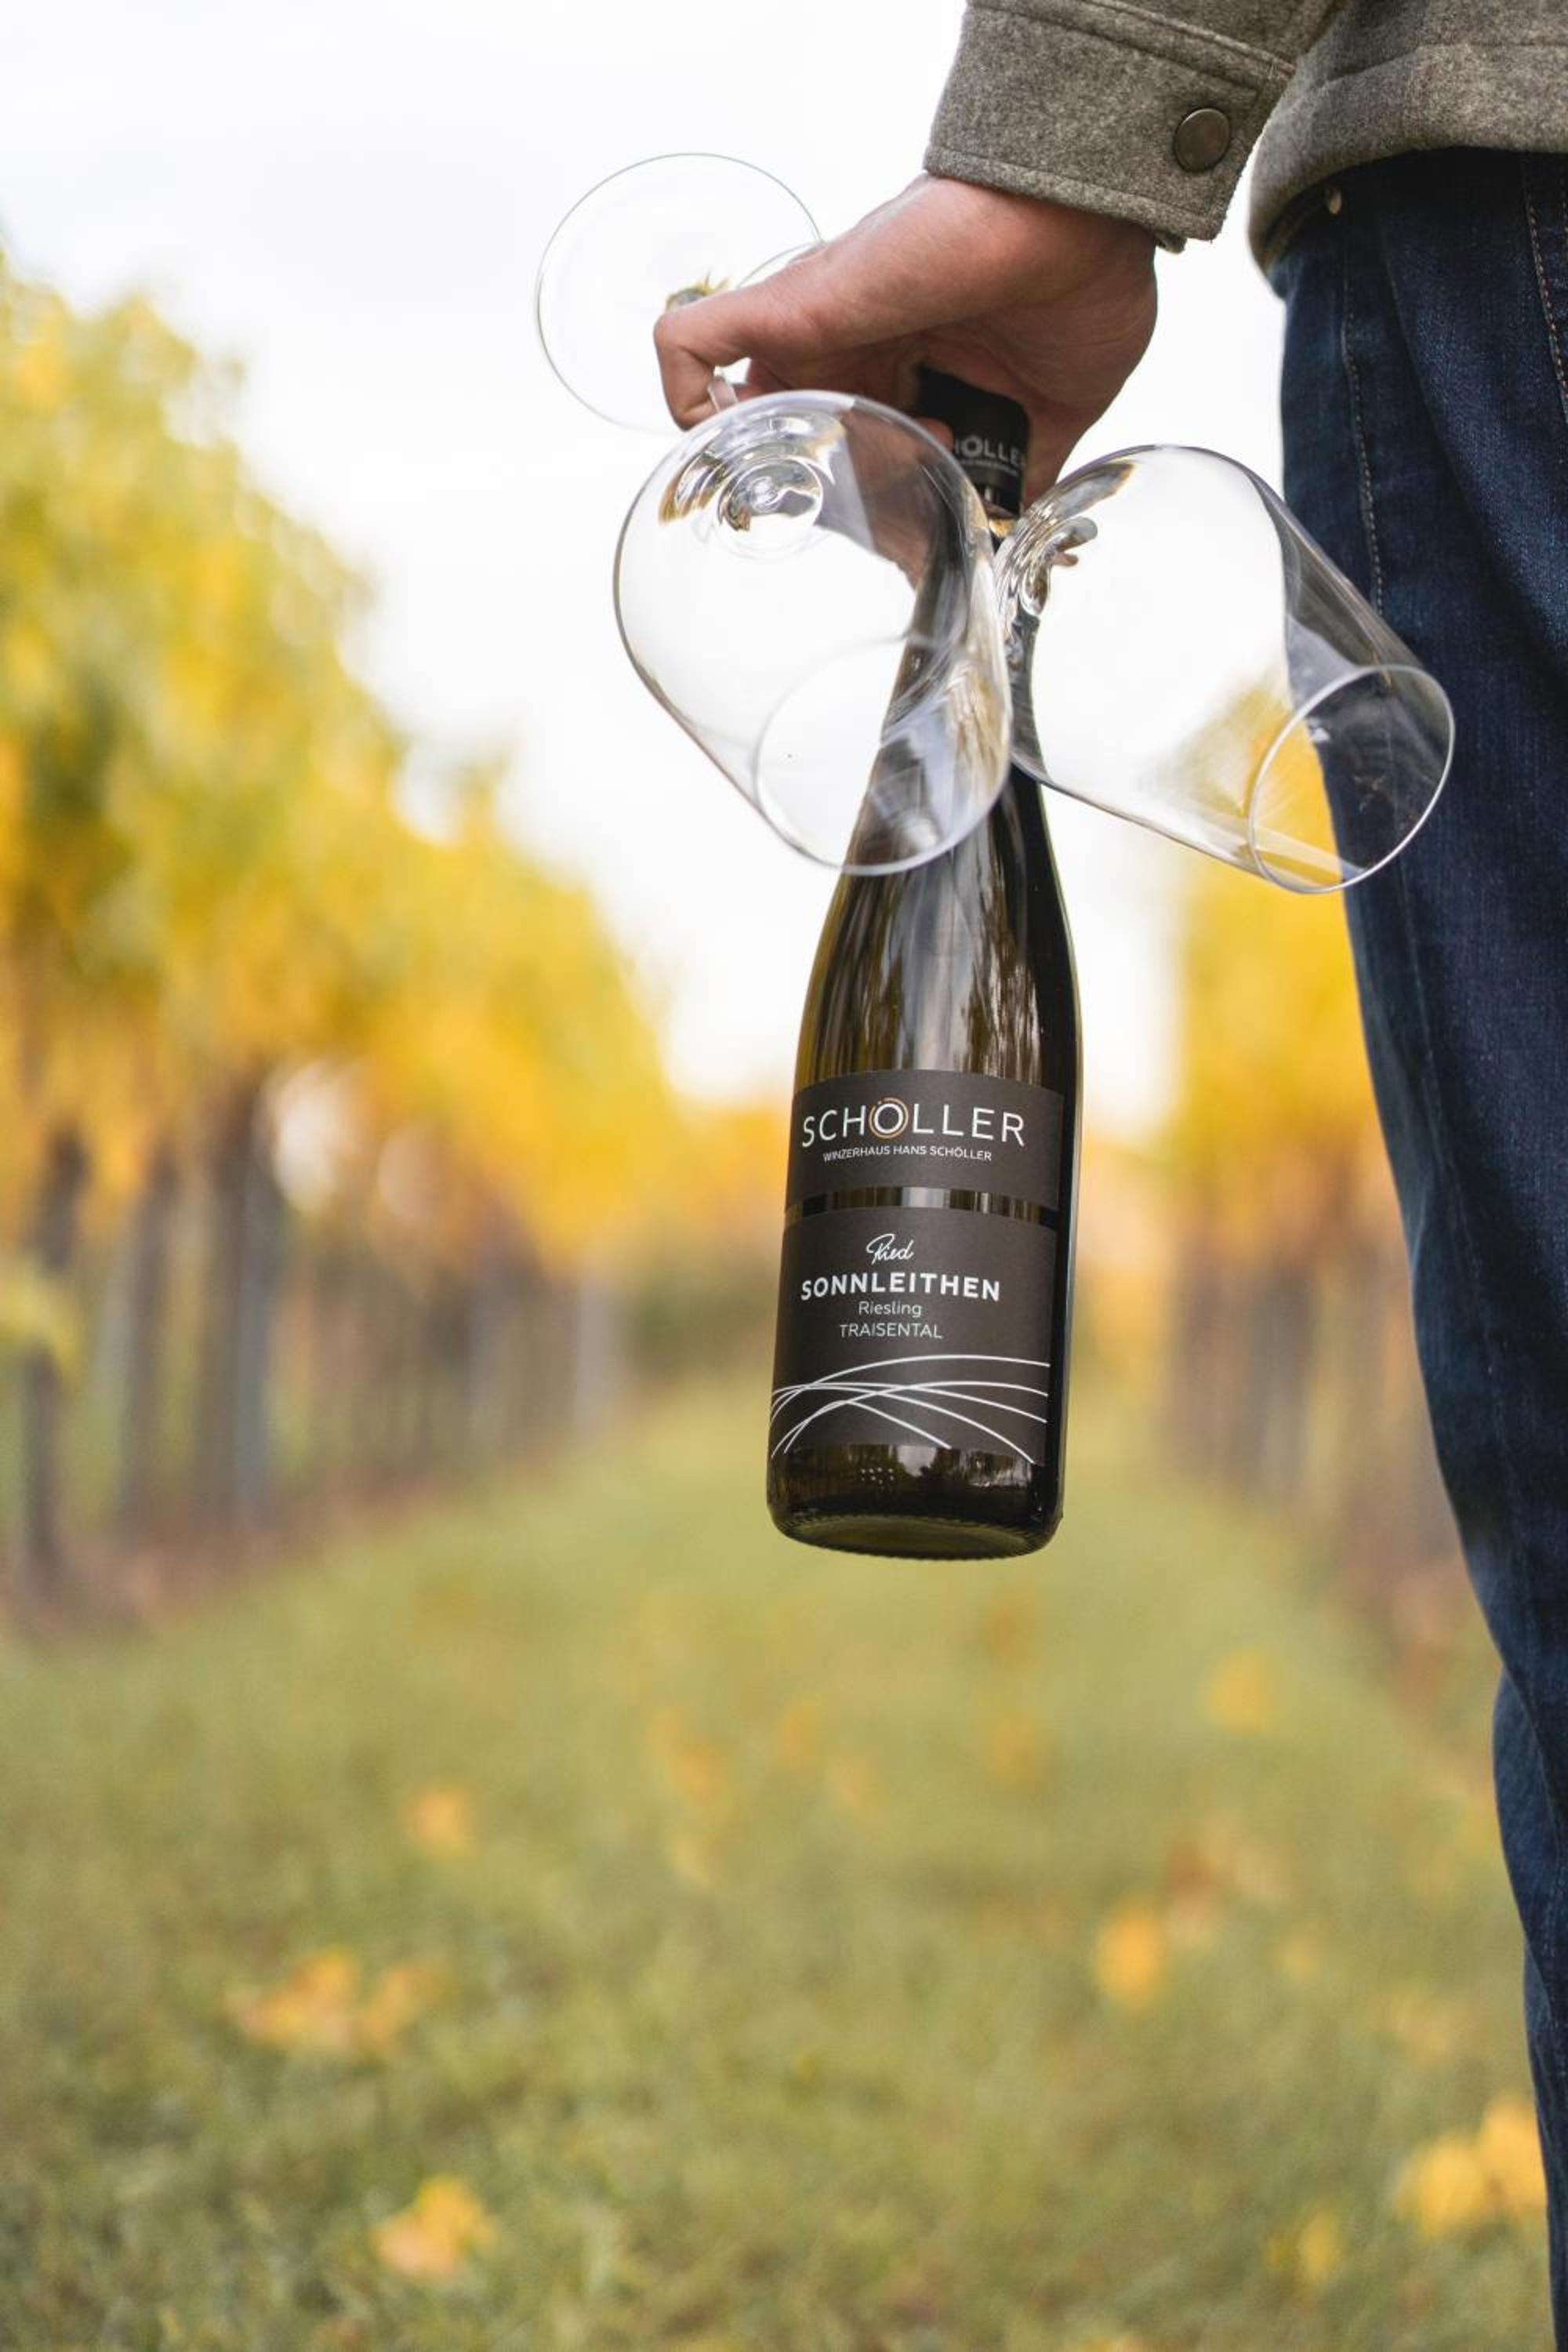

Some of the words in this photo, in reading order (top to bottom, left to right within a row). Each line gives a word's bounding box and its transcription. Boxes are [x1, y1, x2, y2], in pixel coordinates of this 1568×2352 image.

[822, 1145, 890, 1162] WINZERHAUS
[893, 1145, 927, 1156] HANS
[929, 1146, 992, 1162] SCHÖLLER
[800, 1272, 1001, 1302] SONNLEITHEN
[858, 1301, 923, 1318] Riesling
[839, 1323, 944, 1340] TRAISENTAL
